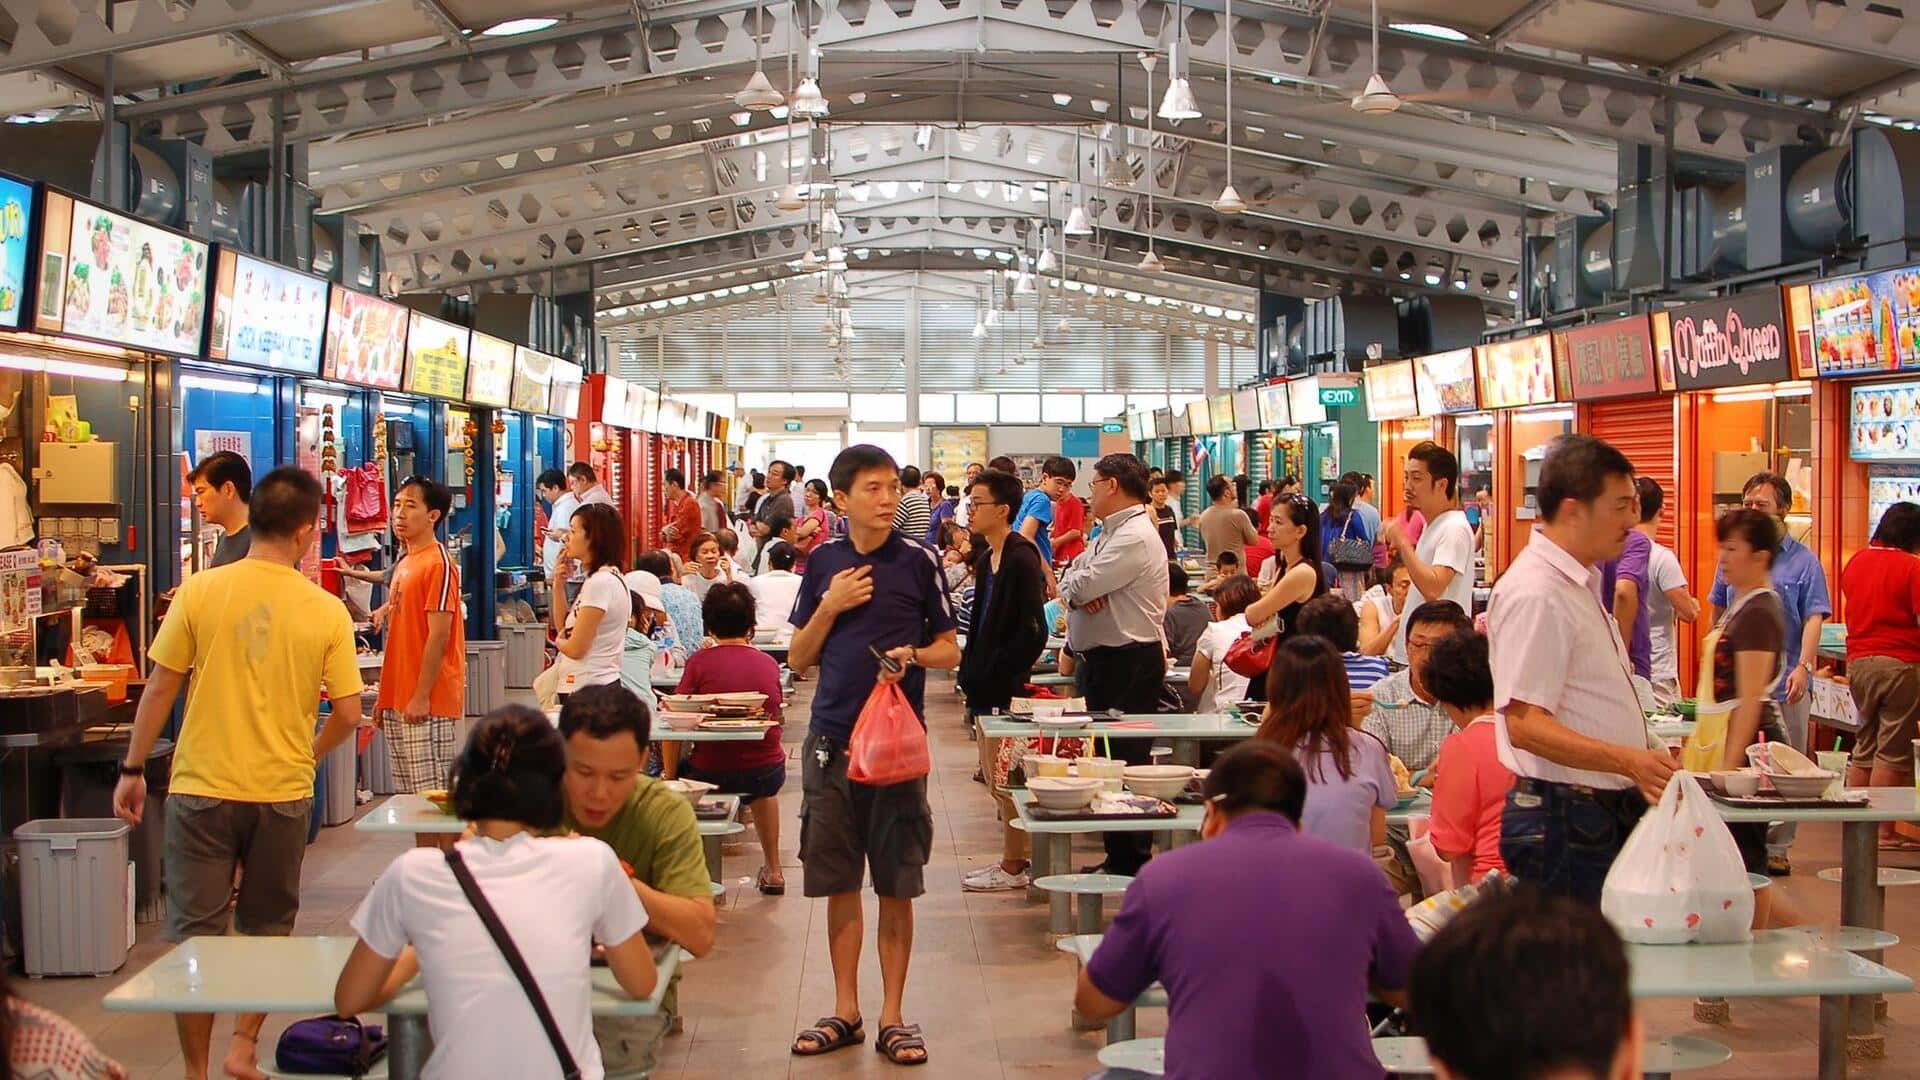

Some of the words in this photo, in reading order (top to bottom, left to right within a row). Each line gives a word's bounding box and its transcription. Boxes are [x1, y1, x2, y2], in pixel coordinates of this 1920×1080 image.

[1674, 316, 1729, 378] Muffin
[1726, 307, 1780, 376] Queen
[1325, 391, 1353, 403] EXIT
